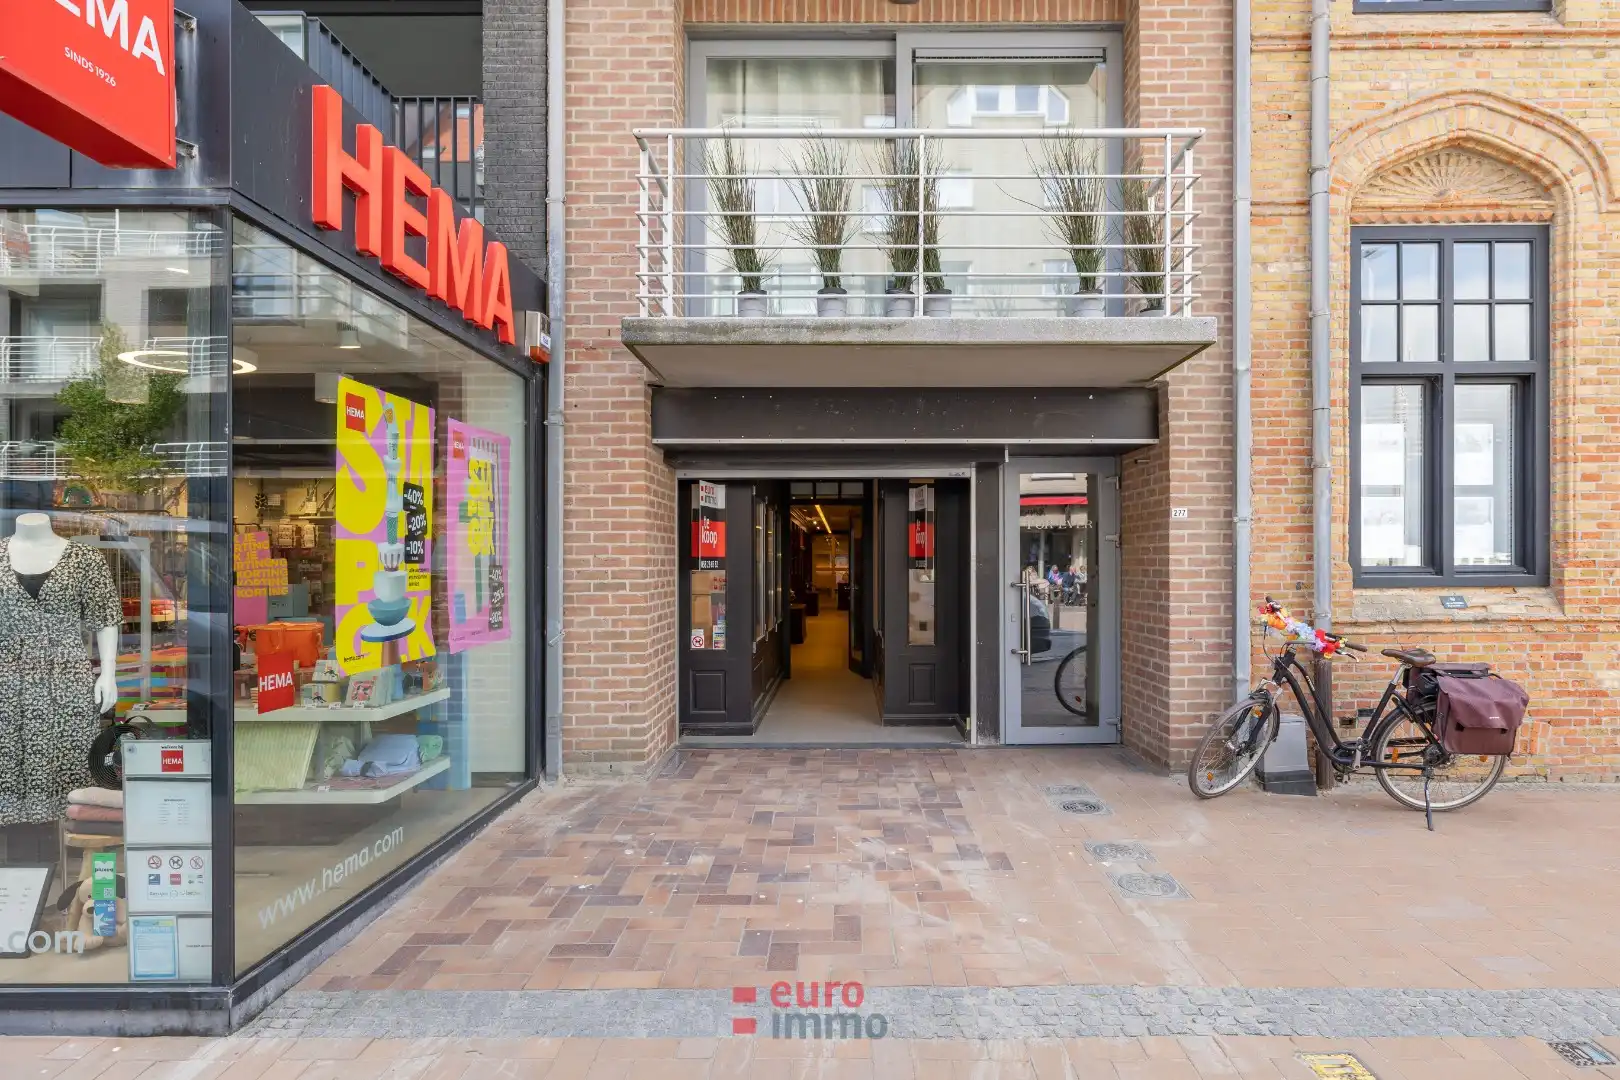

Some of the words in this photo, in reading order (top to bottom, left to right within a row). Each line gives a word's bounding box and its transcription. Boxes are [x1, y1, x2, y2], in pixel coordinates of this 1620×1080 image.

[55, 0, 166, 76] MA
[64, 46, 95, 73] SINDS
[95, 66, 117, 87] 1926
[312, 84, 516, 345] HEMA
[346, 405, 365, 419] HEMA
[404, 488, 424, 506] -40%
[408, 513, 426, 531] -20%
[1173, 509, 1186, 517] 277
[406, 540, 424, 555] -10%
[259, 671, 293, 693] HEMA
[162, 757, 183, 765] HEMA
[258, 826, 404, 930] www.hema.com
